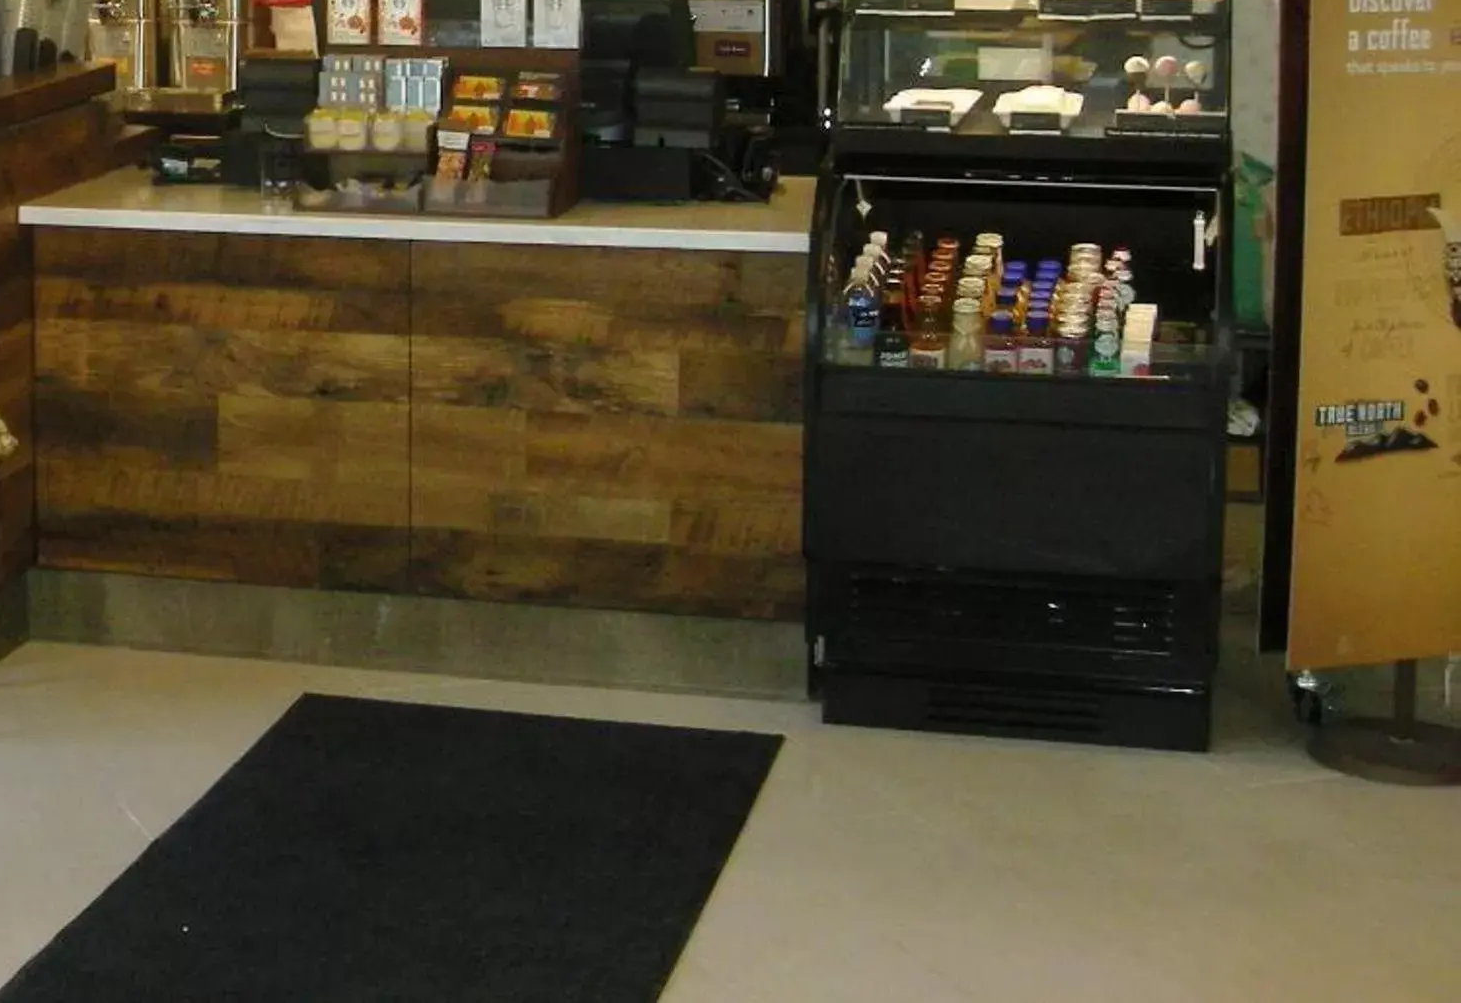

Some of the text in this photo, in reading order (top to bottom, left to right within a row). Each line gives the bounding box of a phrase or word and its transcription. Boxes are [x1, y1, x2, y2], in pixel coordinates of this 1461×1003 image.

[1348, 18, 1431, 51] a coffee
[1319, 401, 1402, 425] TRUE NORTH
